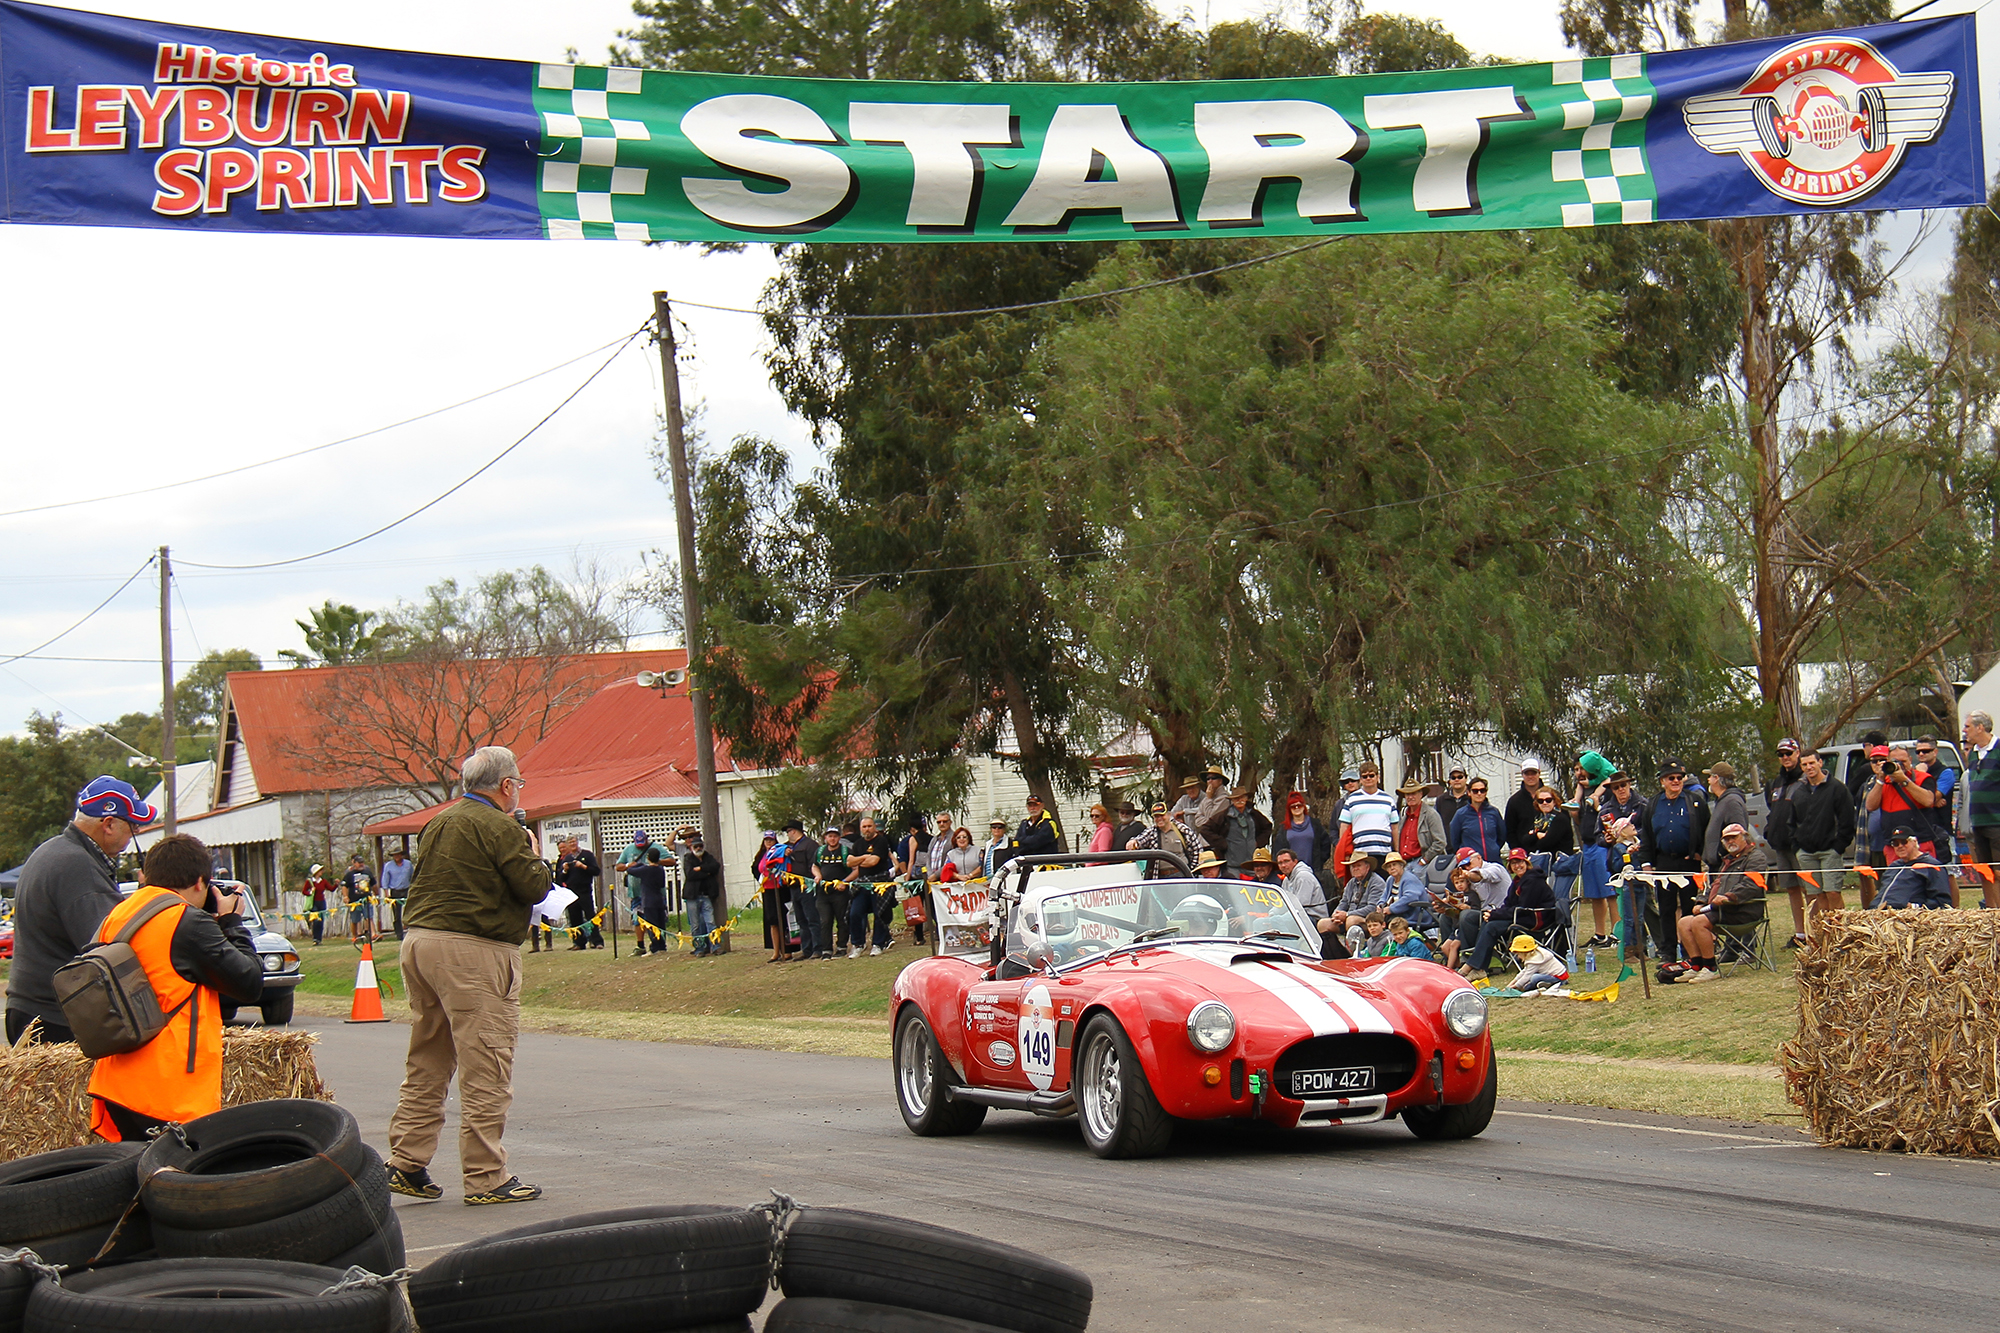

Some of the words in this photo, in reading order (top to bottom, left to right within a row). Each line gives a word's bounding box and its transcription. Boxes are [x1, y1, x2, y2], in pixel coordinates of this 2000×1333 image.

[154, 42, 358, 88] Historic
[1773, 48, 1861, 82] LEYBURN
[25, 85, 411, 153] LEYBURN
[680, 86, 1532, 232] START
[151, 145, 486, 216] SPRINTS
[1780, 163, 1868, 195] SPRINTS
[1081, 886, 1138, 909] COMPETITORS
[1239, 887, 1284, 909] 149
[1081, 923, 1120, 941] DISPLAYS
[1023, 1029, 1051, 1067] 149
